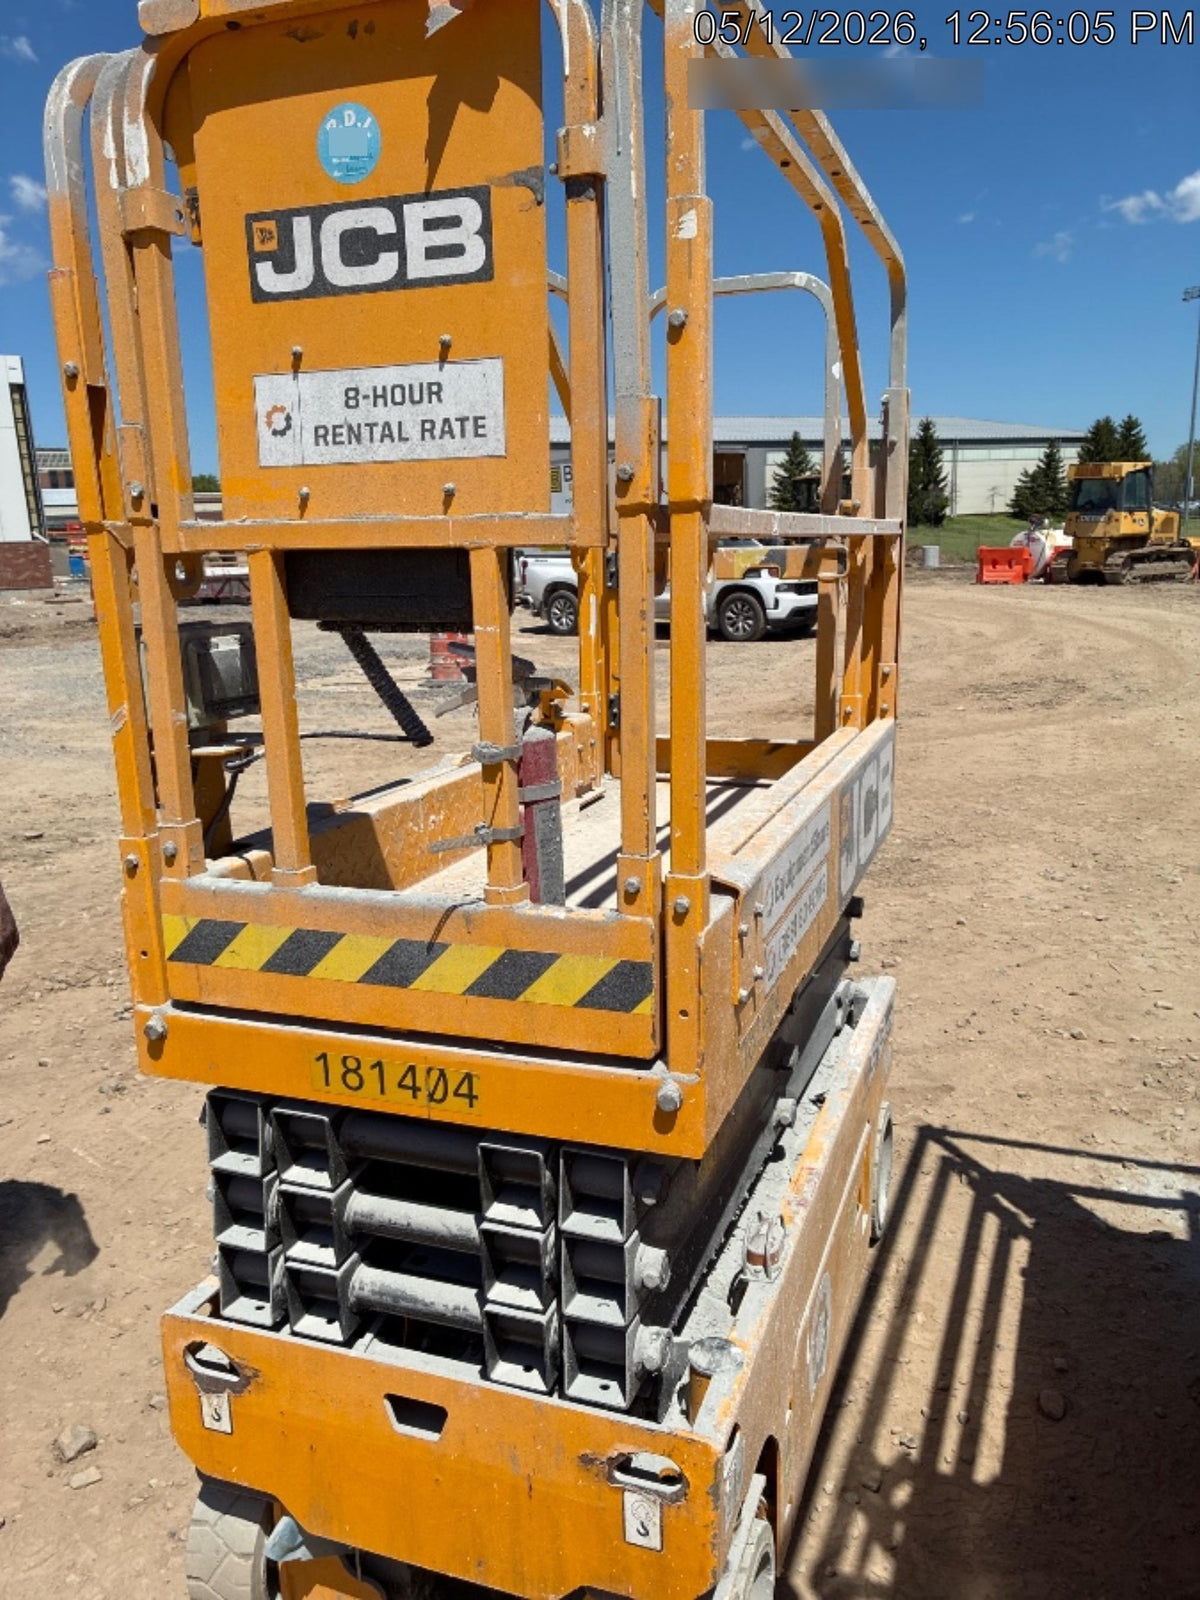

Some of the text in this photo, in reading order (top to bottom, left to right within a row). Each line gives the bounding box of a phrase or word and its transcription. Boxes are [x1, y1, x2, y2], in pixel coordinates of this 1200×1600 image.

[255, 196, 486, 294] JCB
[344, 381, 443, 410] 8-HOUR
[314, 415, 488, 447] RENTAL RATE
[840, 740, 894, 898] JCB
[315, 1052, 480, 1108] 181404
